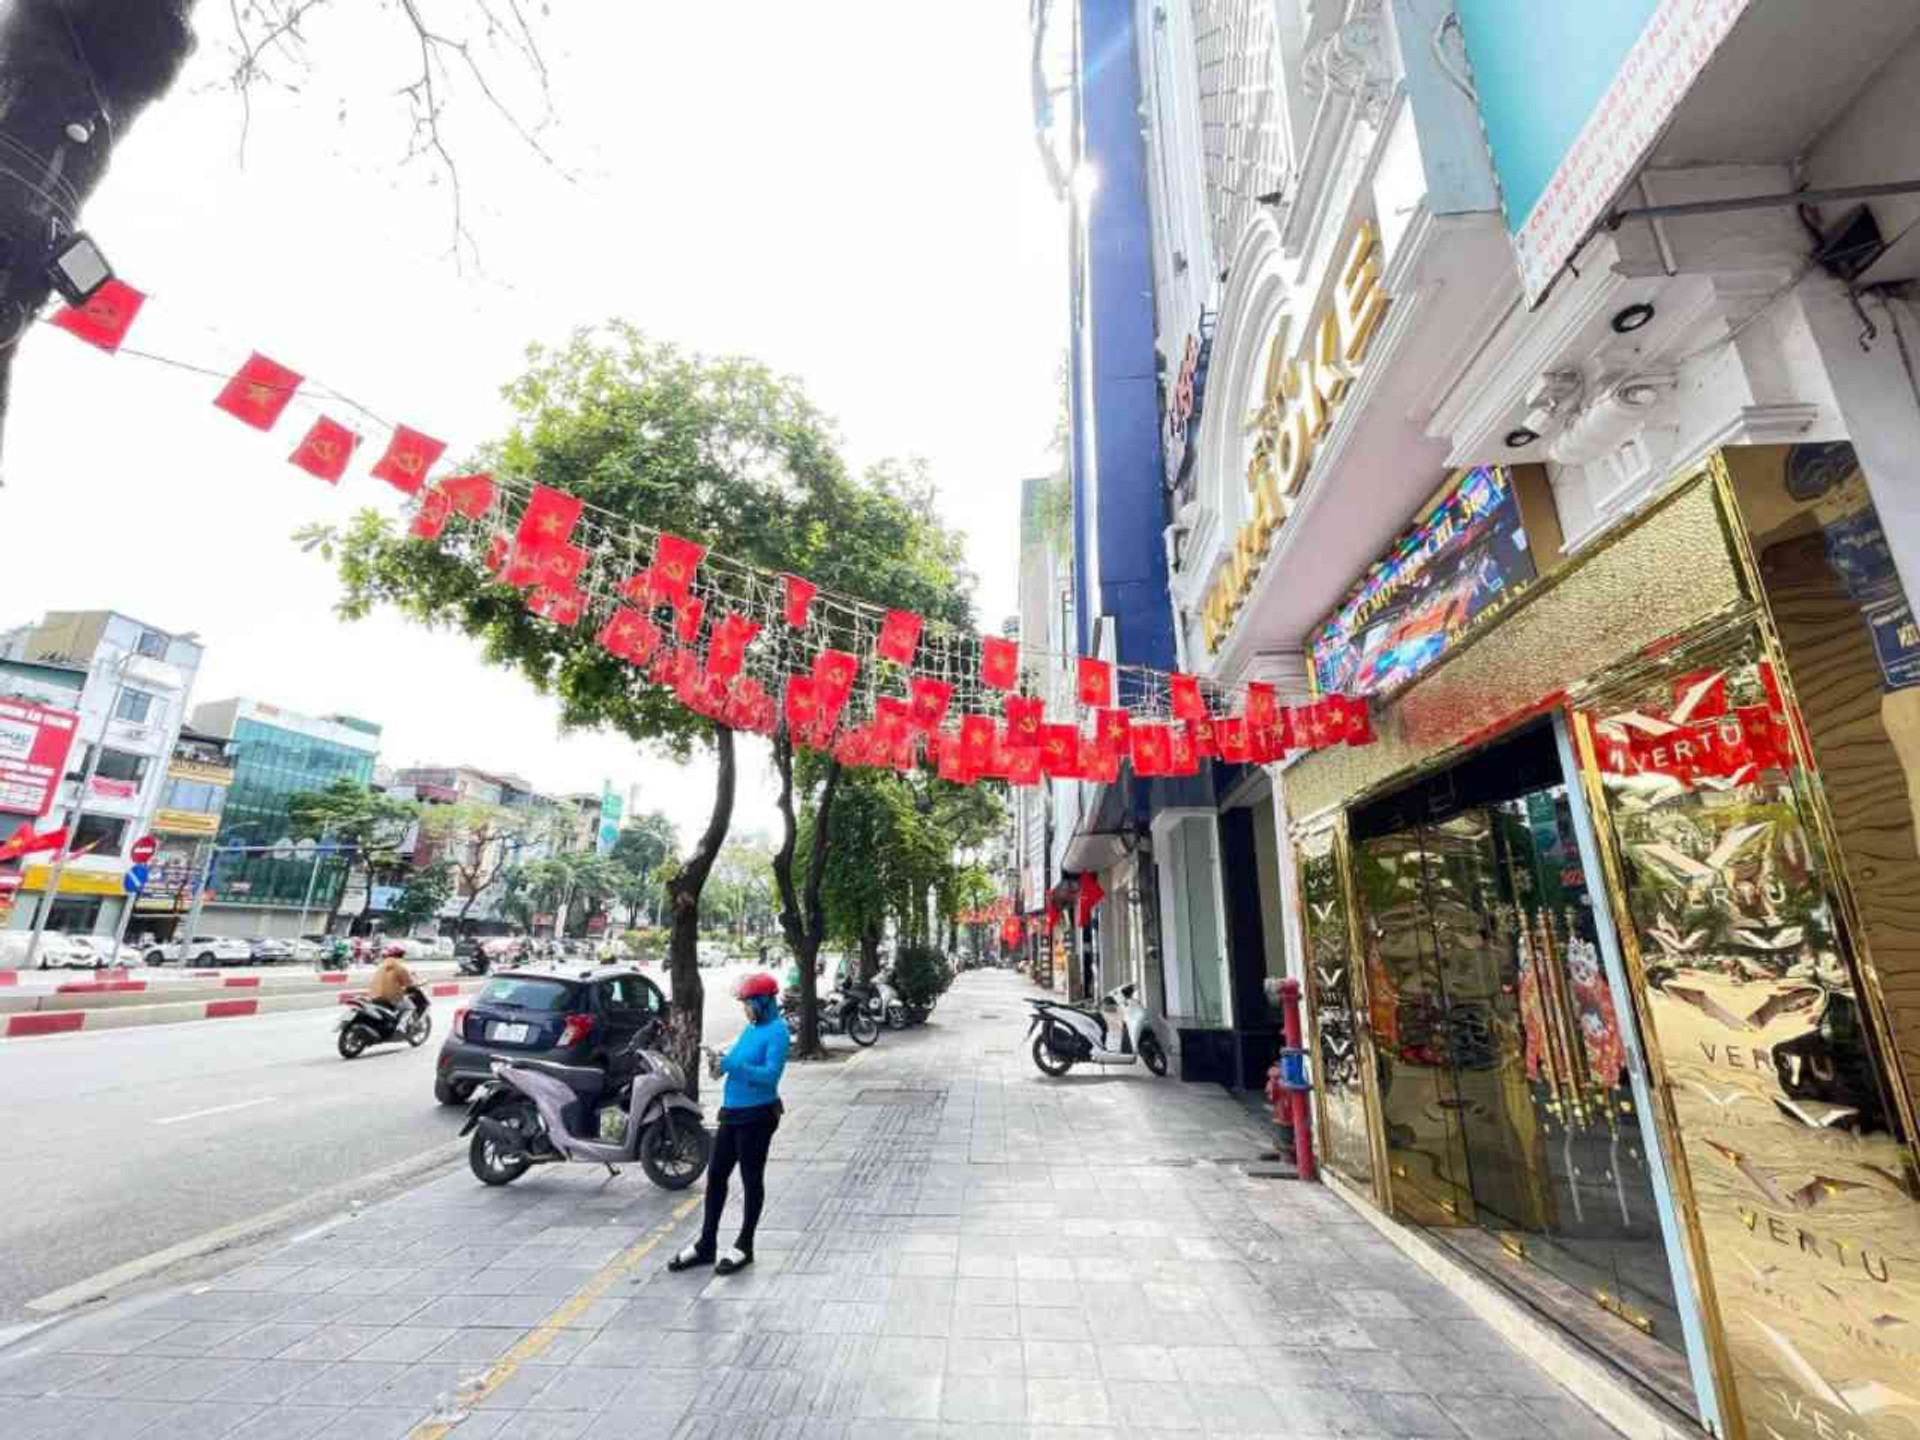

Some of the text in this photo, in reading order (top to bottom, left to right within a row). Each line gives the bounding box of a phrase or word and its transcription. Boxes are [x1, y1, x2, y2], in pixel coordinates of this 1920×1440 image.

[1202, 220, 1392, 655] KARAOKE
[1631, 722, 1742, 776] VERTU
[1661, 878, 1786, 910] VERTU
[1739, 1206, 1889, 1284] VERTU
